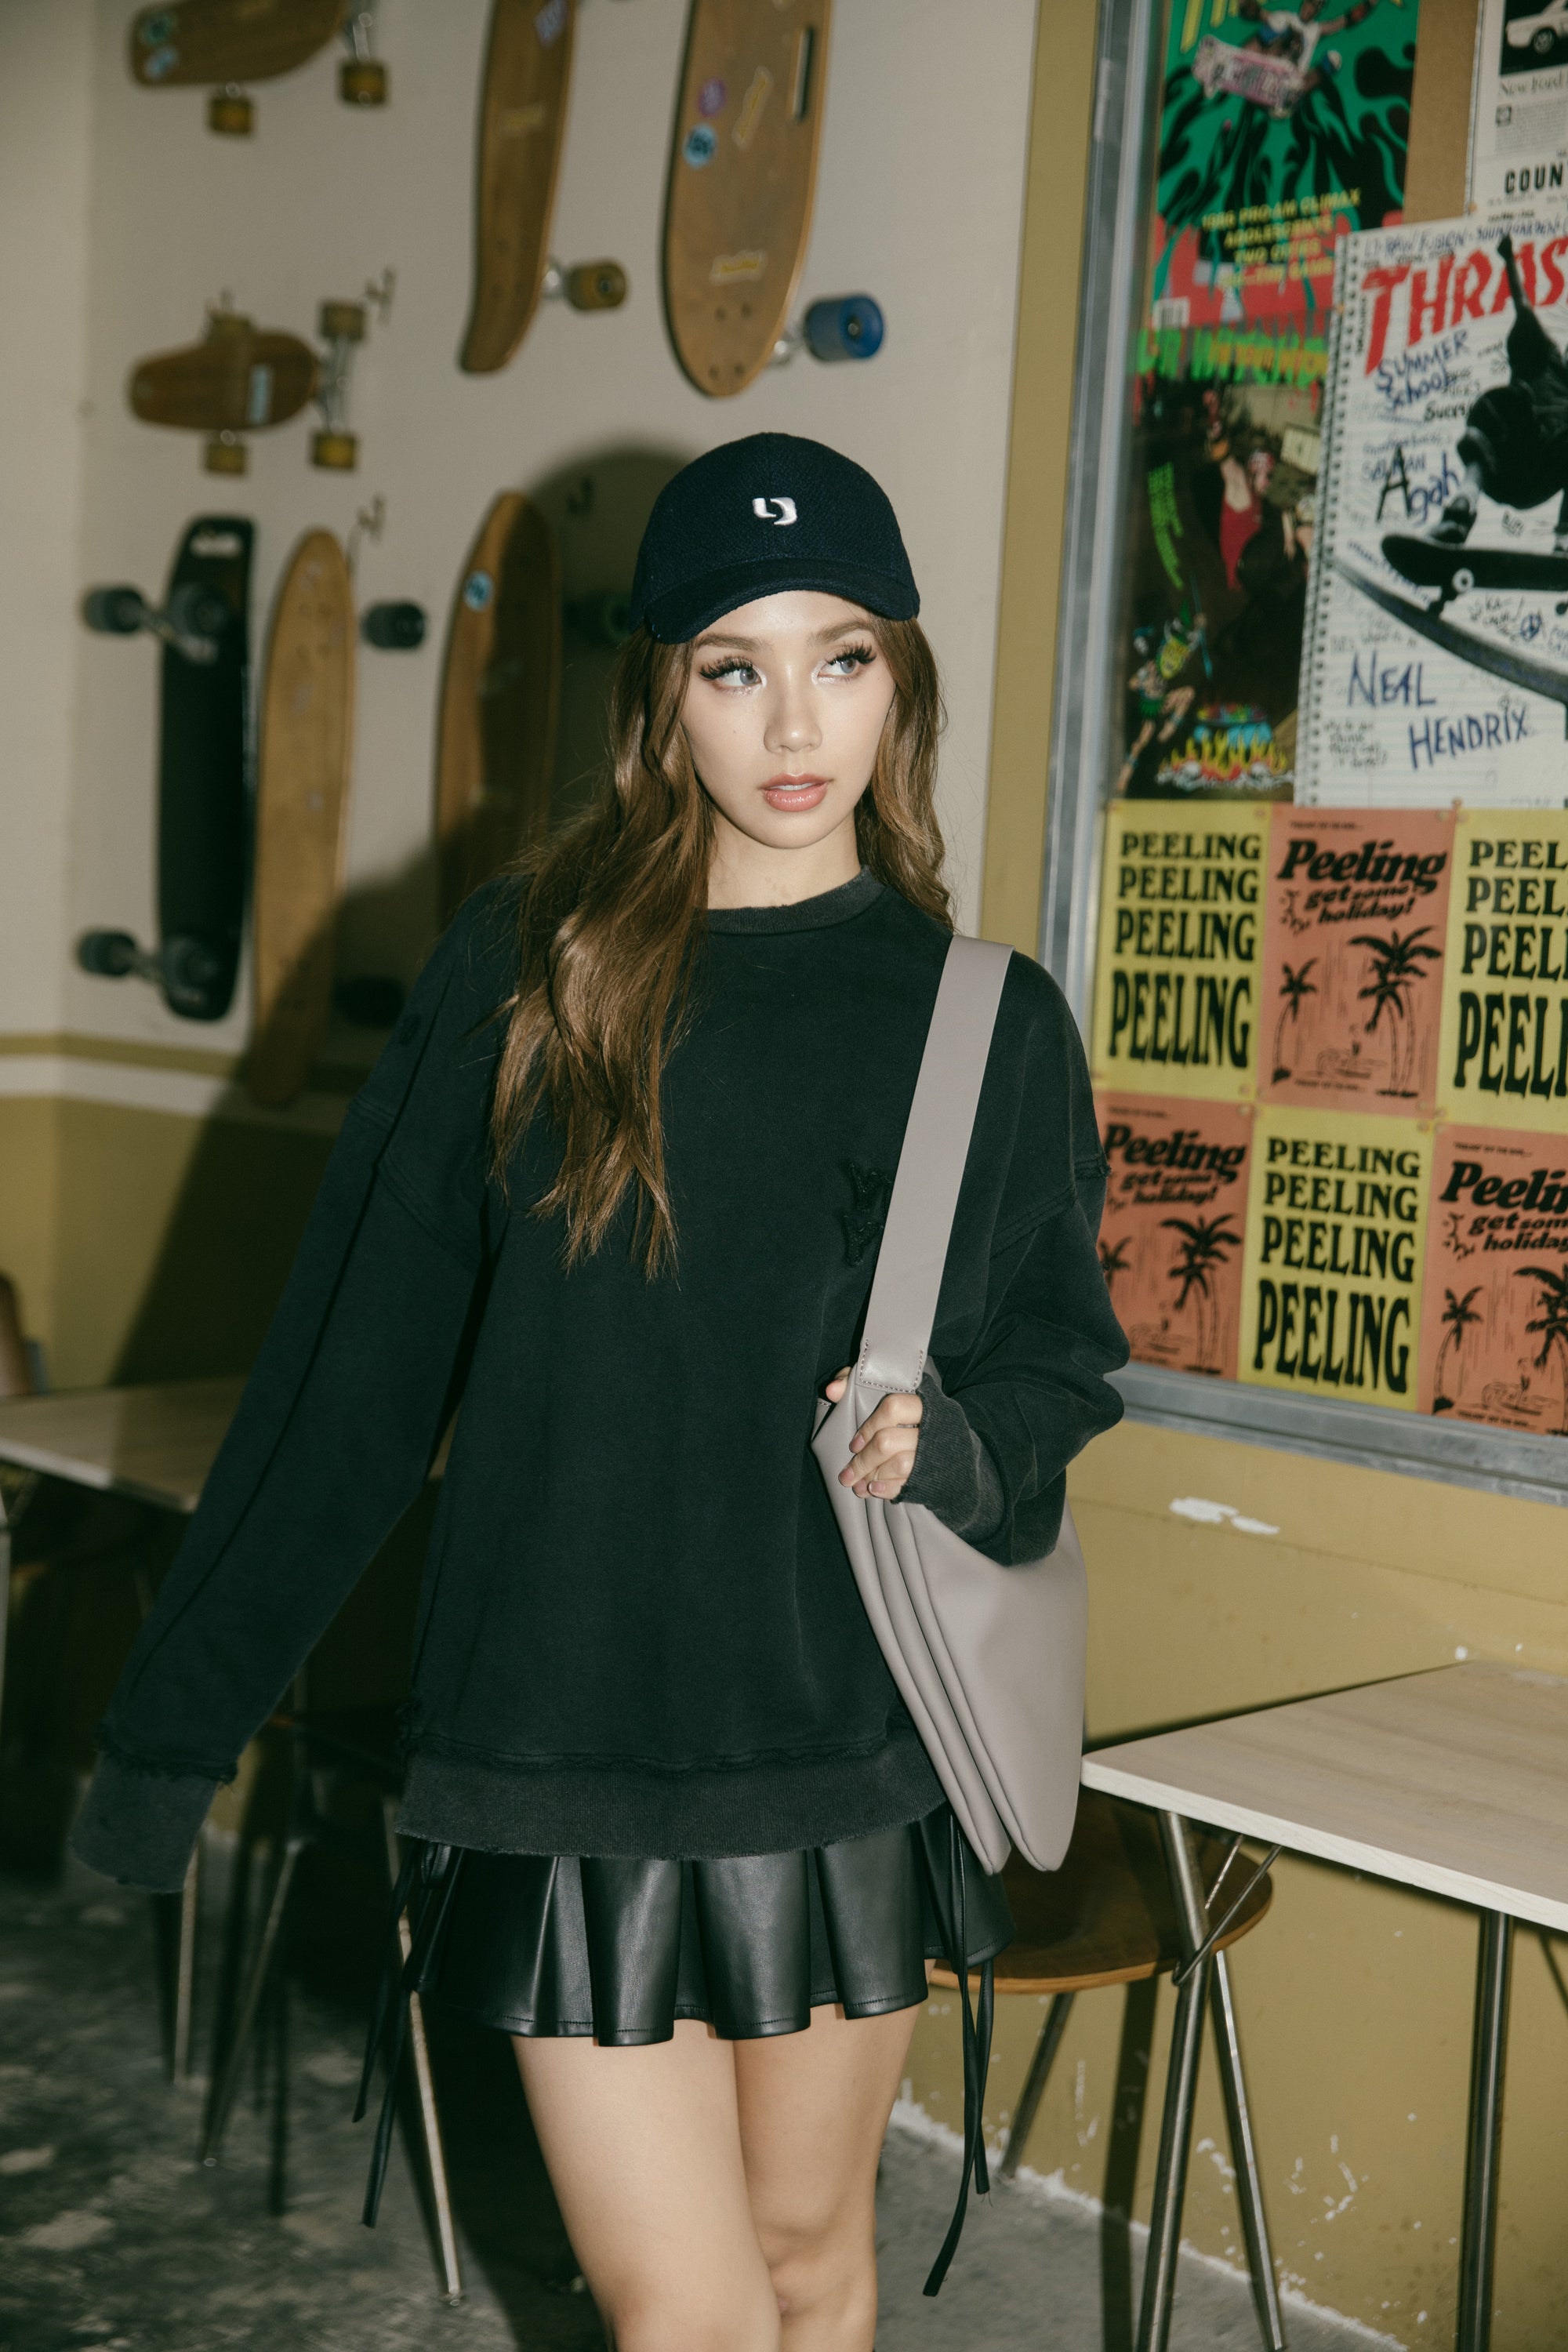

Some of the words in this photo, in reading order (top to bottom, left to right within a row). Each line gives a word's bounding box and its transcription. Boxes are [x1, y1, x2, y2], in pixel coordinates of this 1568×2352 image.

[1374, 328, 1470, 393] SUMMER
[1375, 444, 1461, 526] Agah
[1347, 650, 1436, 709] NEAL
[1408, 703, 1528, 771] HENDRIX
[1121, 833, 1261, 861] PEELING
[1276, 838, 1448, 895] Peeling
[1469, 840, 1568, 871] PEEL
[1118, 865, 1258, 904] PEELING
[1303, 884, 1352, 911] get
[1316, 897, 1416, 923] holiday!
[1114, 907, 1255, 963] PEELING
[1108, 969, 1250, 1070] PEELING
[1104, 1123, 1247, 1185] Peeling
[1267, 1137, 1421, 1179] PEELING
[1264, 1171, 1418, 1223] PEELING
[1468, 1211, 1519, 1236] get
[1259, 1214, 1415, 1284] PEELING
[1253, 1279, 1410, 1395] PEELING
